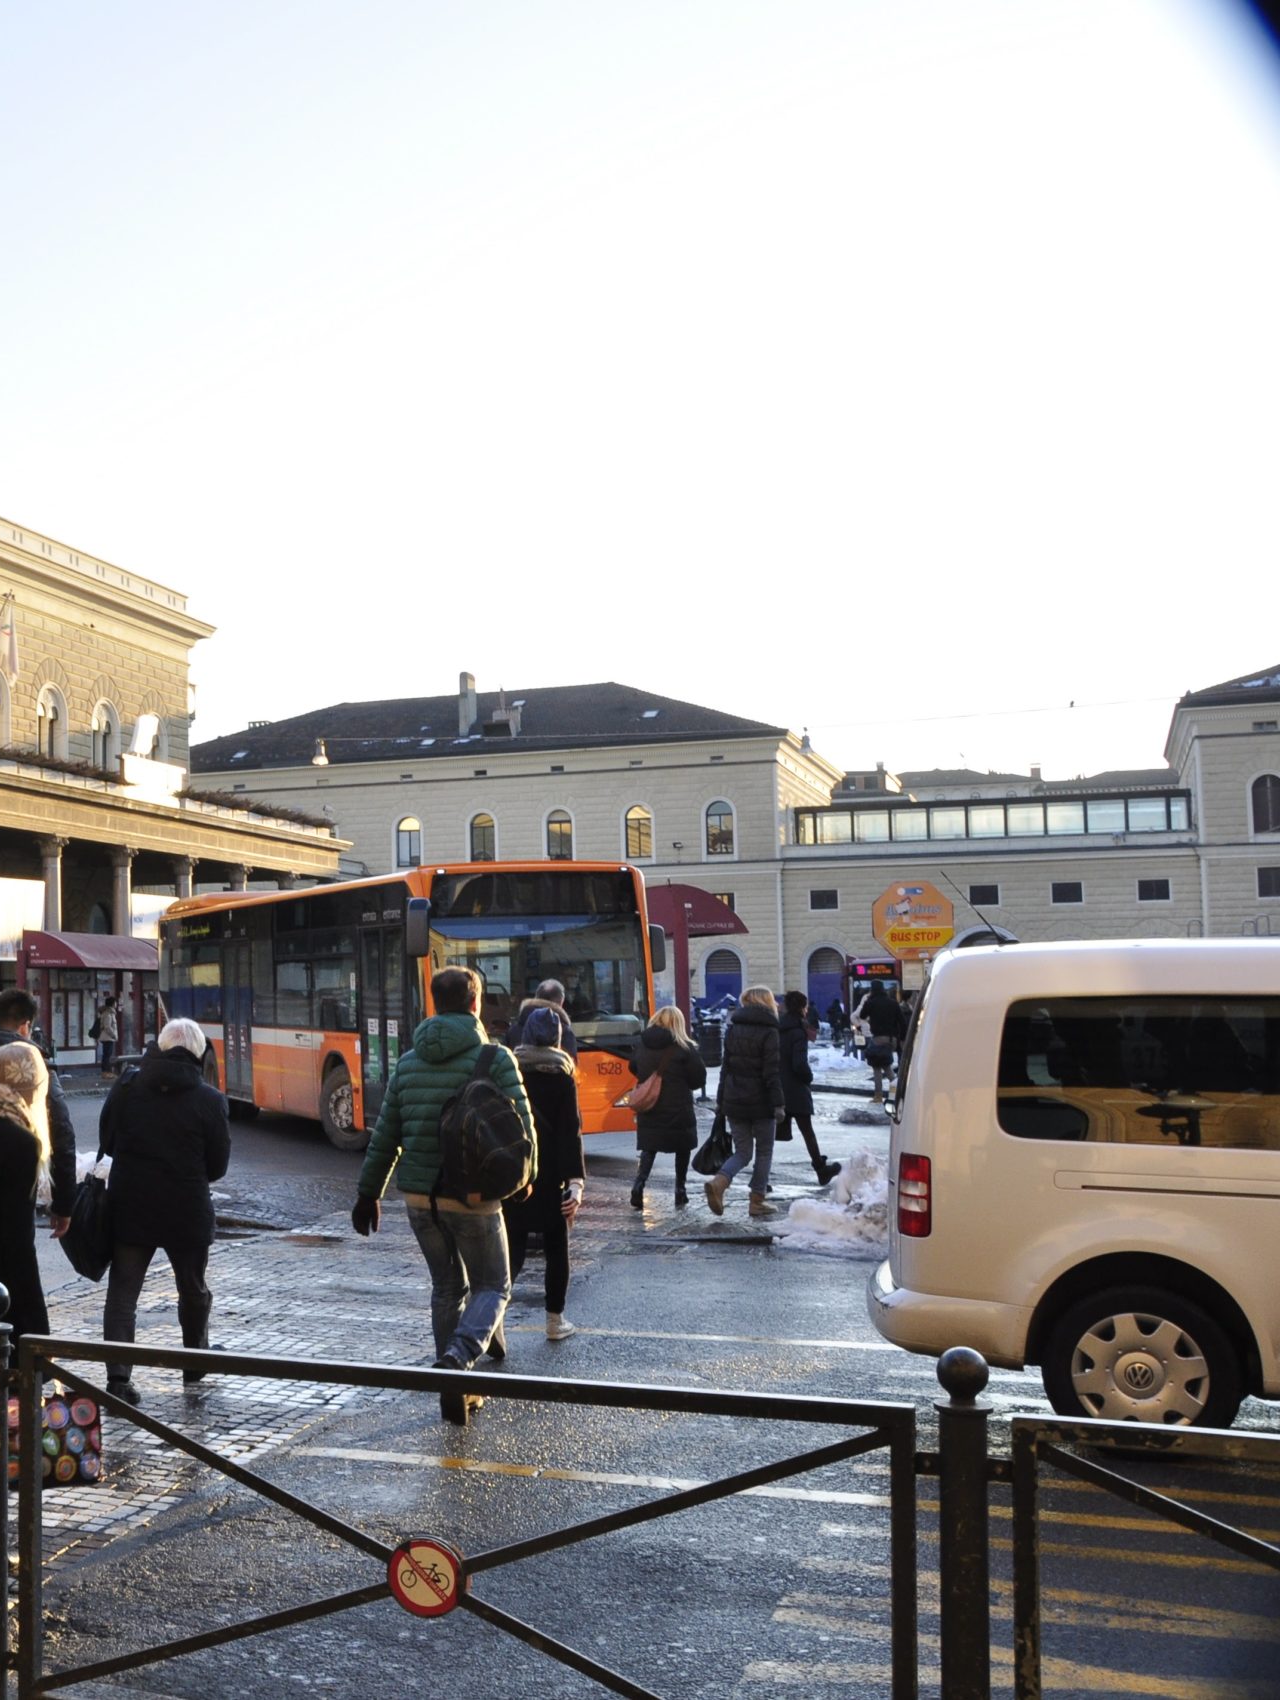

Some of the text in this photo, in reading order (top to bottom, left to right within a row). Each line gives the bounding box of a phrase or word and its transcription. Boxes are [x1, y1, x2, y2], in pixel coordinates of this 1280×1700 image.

[890, 931, 941, 942] BUS STOP
[597, 1062, 623, 1076] 1528
